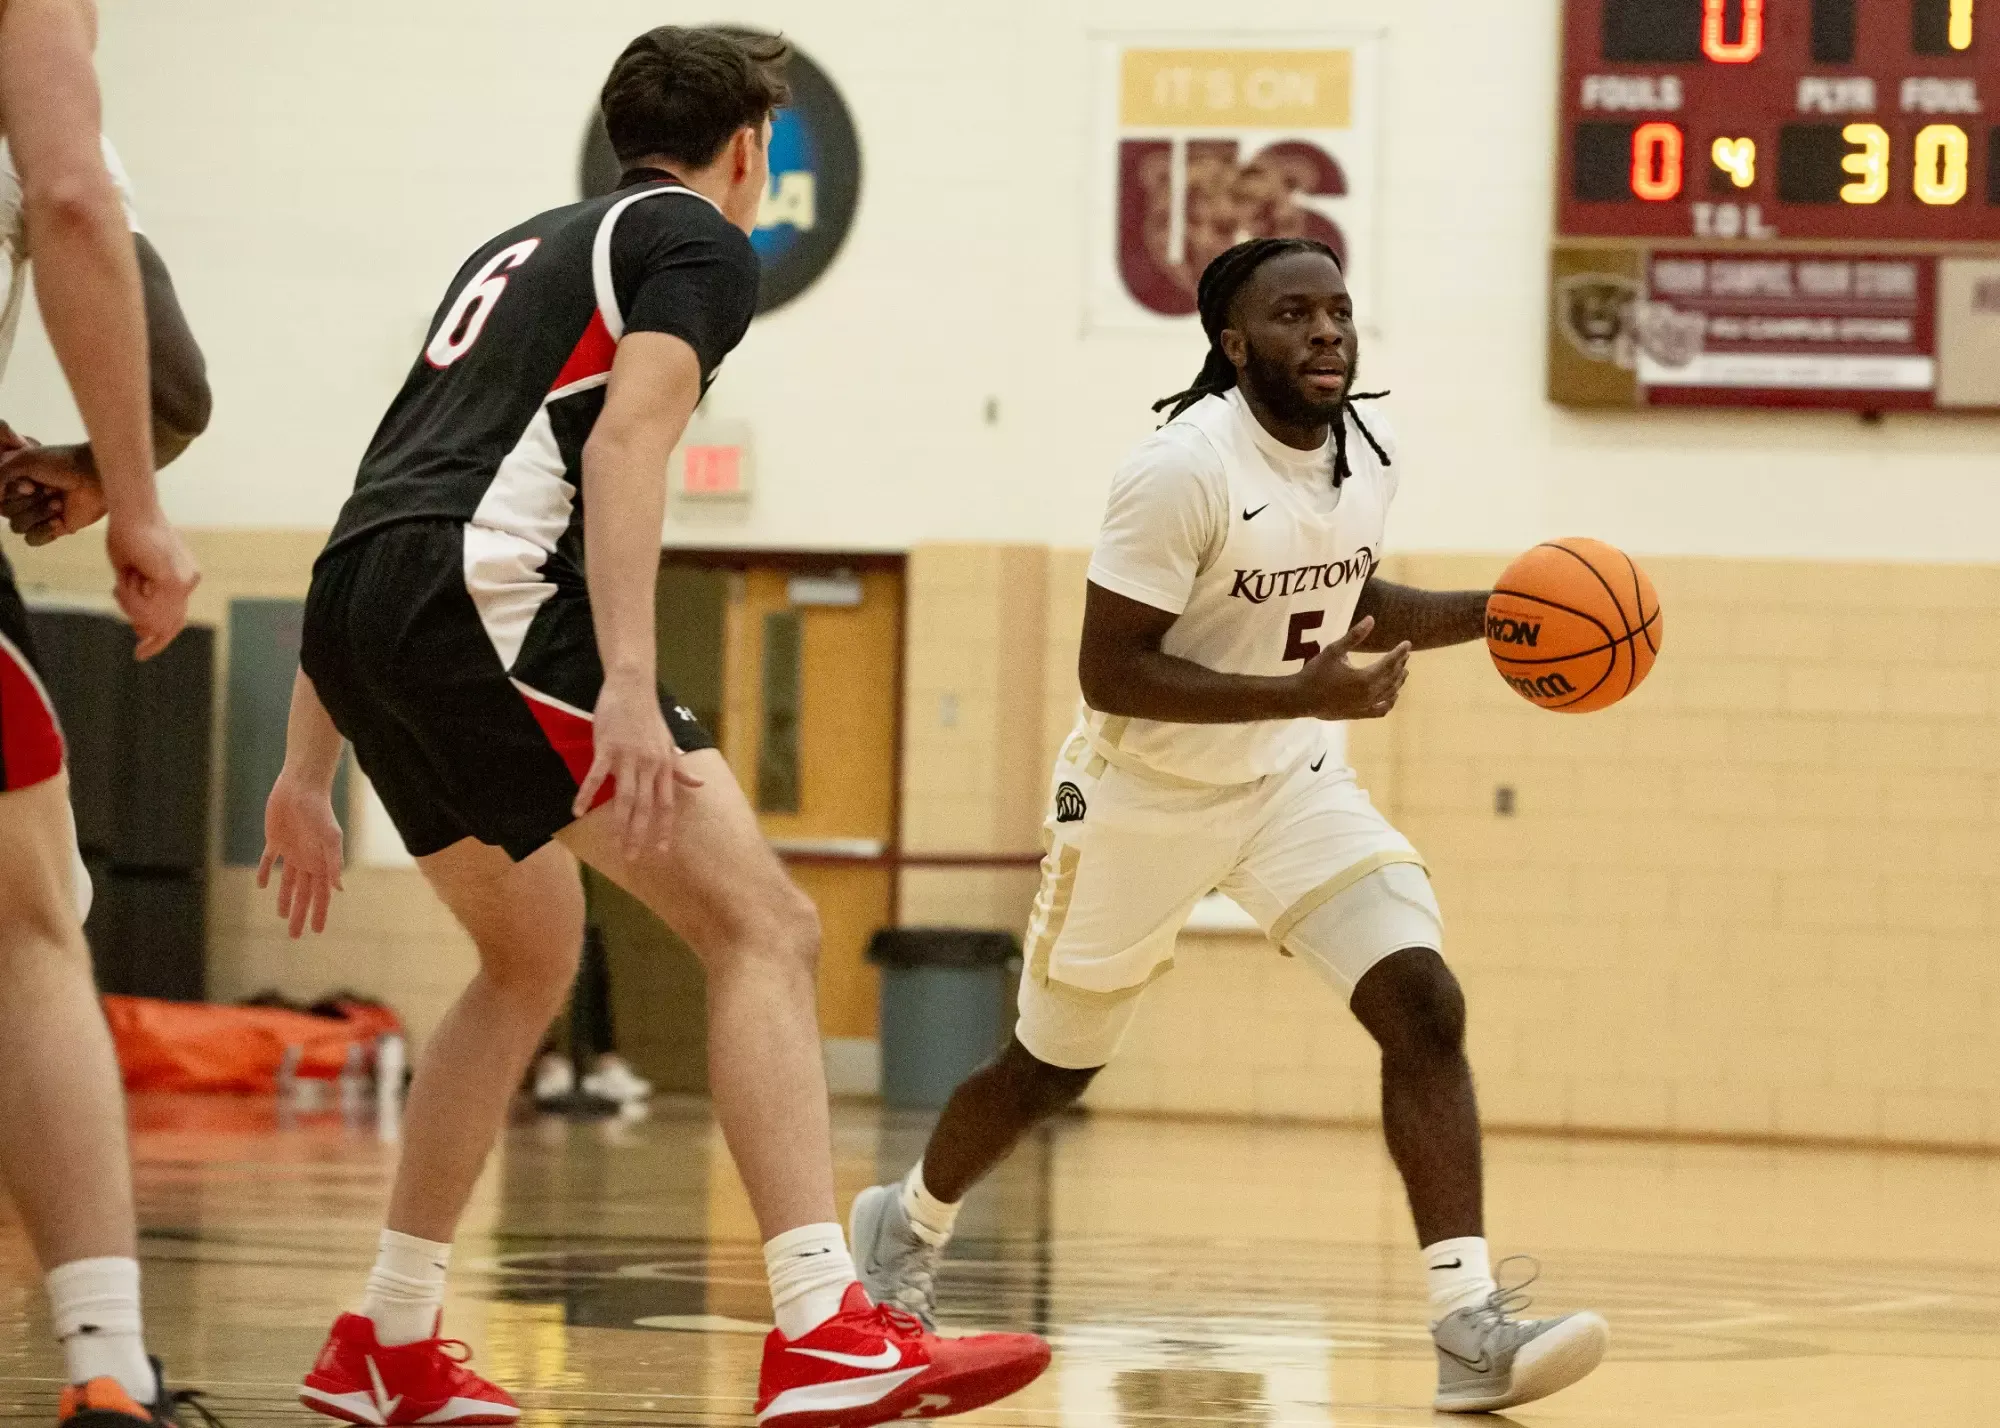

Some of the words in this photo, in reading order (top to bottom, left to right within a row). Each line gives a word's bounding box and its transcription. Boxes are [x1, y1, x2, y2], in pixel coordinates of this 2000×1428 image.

[1245, 67, 1318, 110] ON
[1581, 75, 1683, 111] FOULS
[1797, 77, 1877, 112] PLYR
[1900, 77, 1980, 113] FOUL
[1631, 121, 1683, 201] 0
[1711, 137, 1756, 188] 4
[424, 237, 542, 370] 6
[1282, 610, 1324, 668] 5
